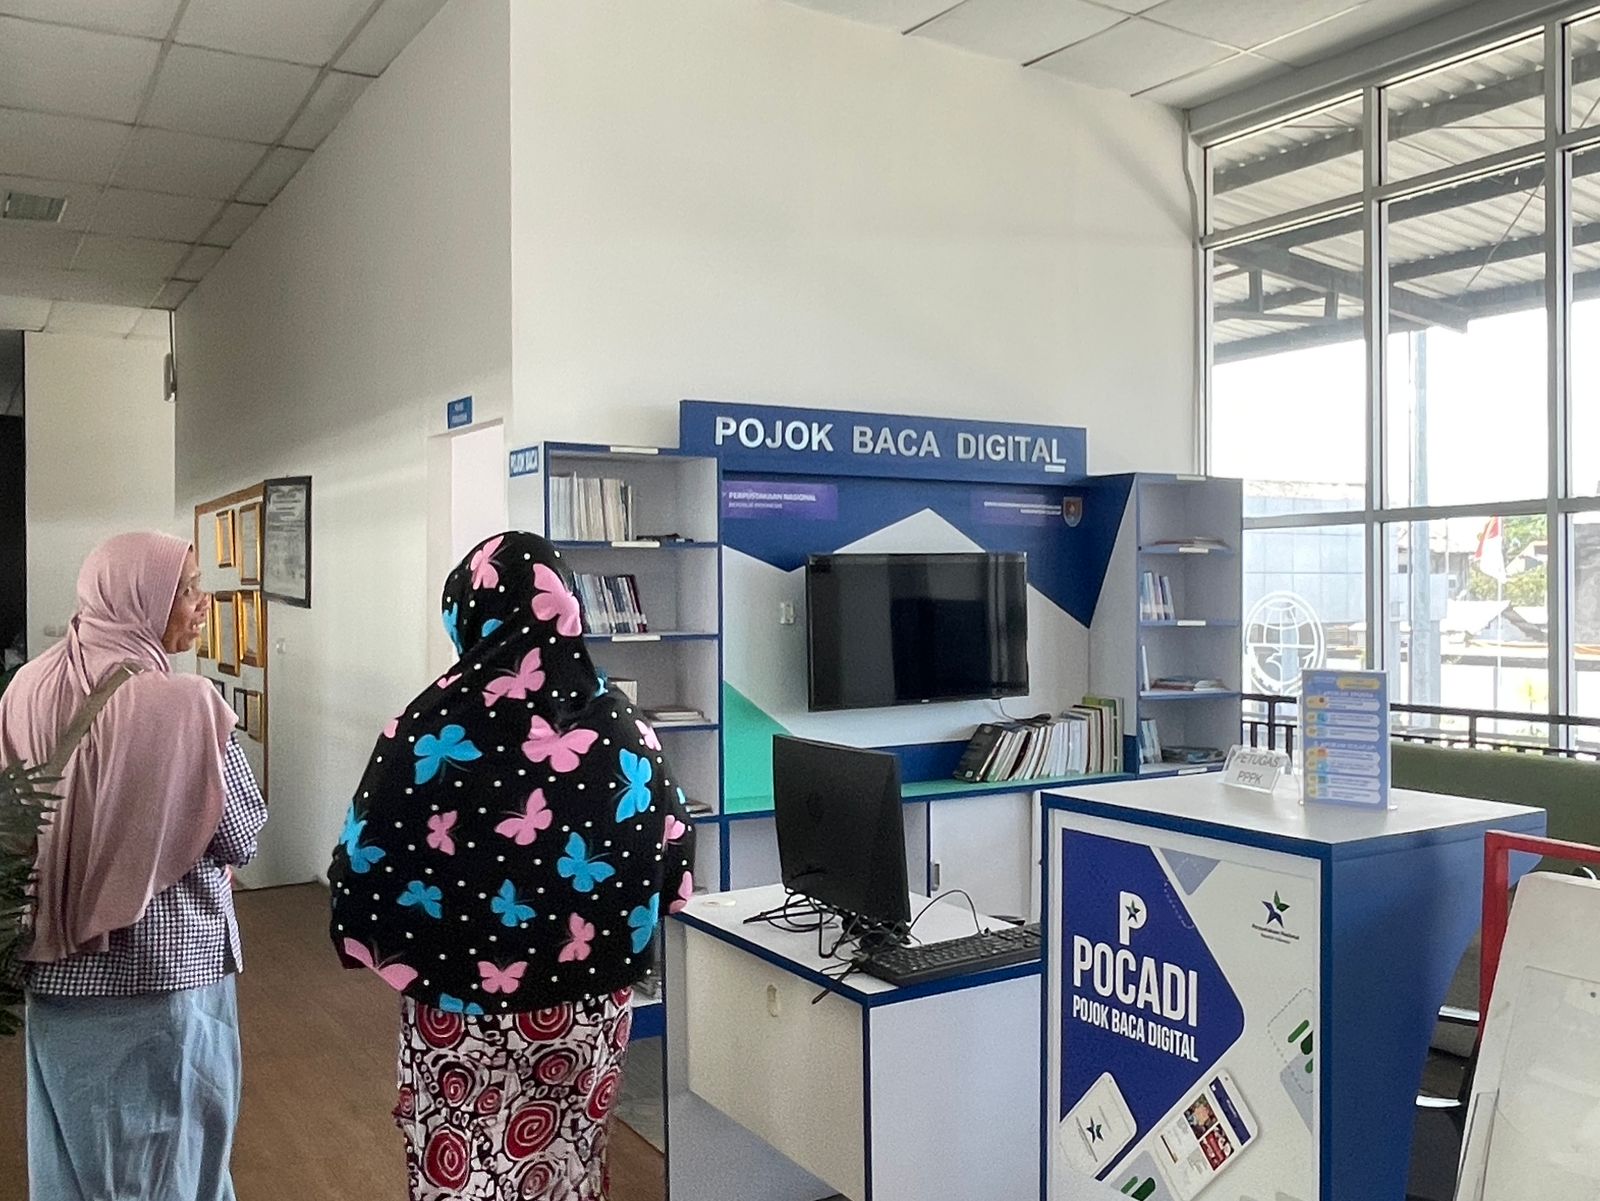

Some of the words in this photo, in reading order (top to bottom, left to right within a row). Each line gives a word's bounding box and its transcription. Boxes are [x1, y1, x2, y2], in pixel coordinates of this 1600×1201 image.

[715, 416, 834, 452] POJOK
[853, 425, 941, 458] BACA
[957, 432, 1067, 465] DIGITAL
[1234, 752, 1280, 768] PETUGAS
[1237, 770, 1263, 784] PPPK
[1119, 890, 1148, 945] P
[1073, 935, 1198, 1027] POCADI
[1072, 994, 1109, 1030] POJOK
[1112, 1008, 1146, 1043] BACA
[1148, 1018, 1199, 1063] DIGITAL
